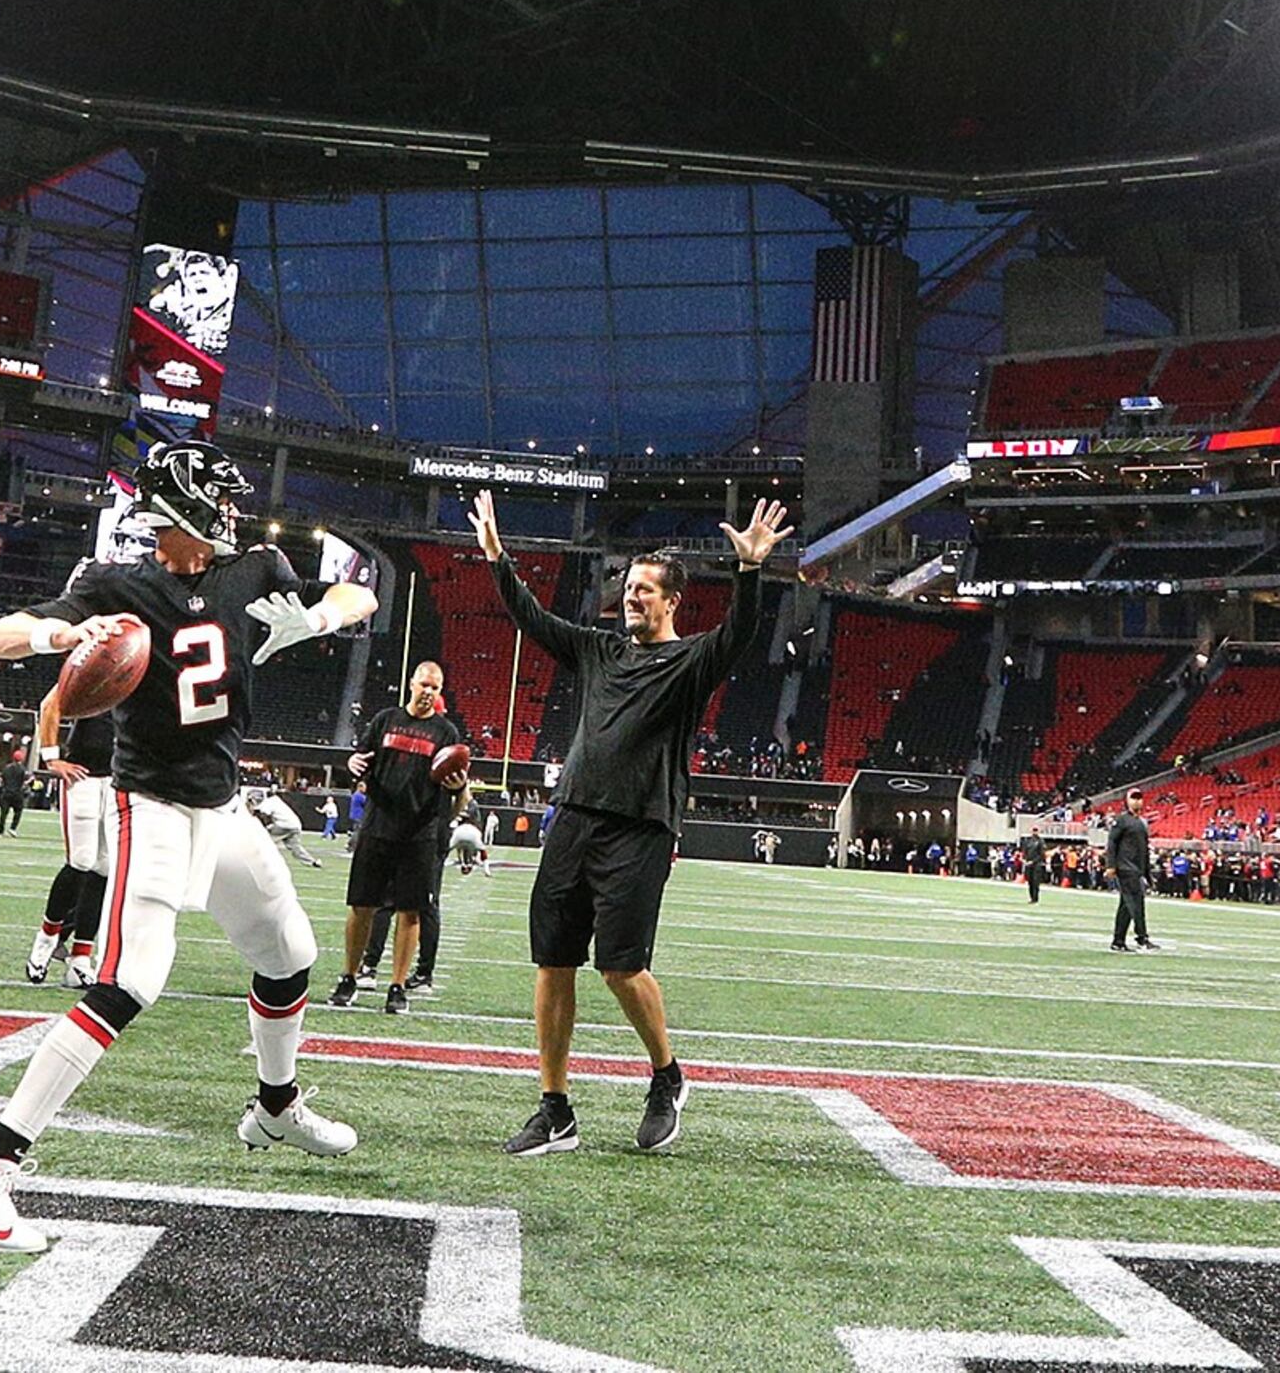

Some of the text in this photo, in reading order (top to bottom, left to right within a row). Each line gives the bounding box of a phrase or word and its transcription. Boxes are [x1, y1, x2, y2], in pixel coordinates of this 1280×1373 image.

[139, 393, 211, 418] WELCOME
[413, 457, 604, 489] Mercedes-Benz Stadium
[172, 622, 229, 725] 2
